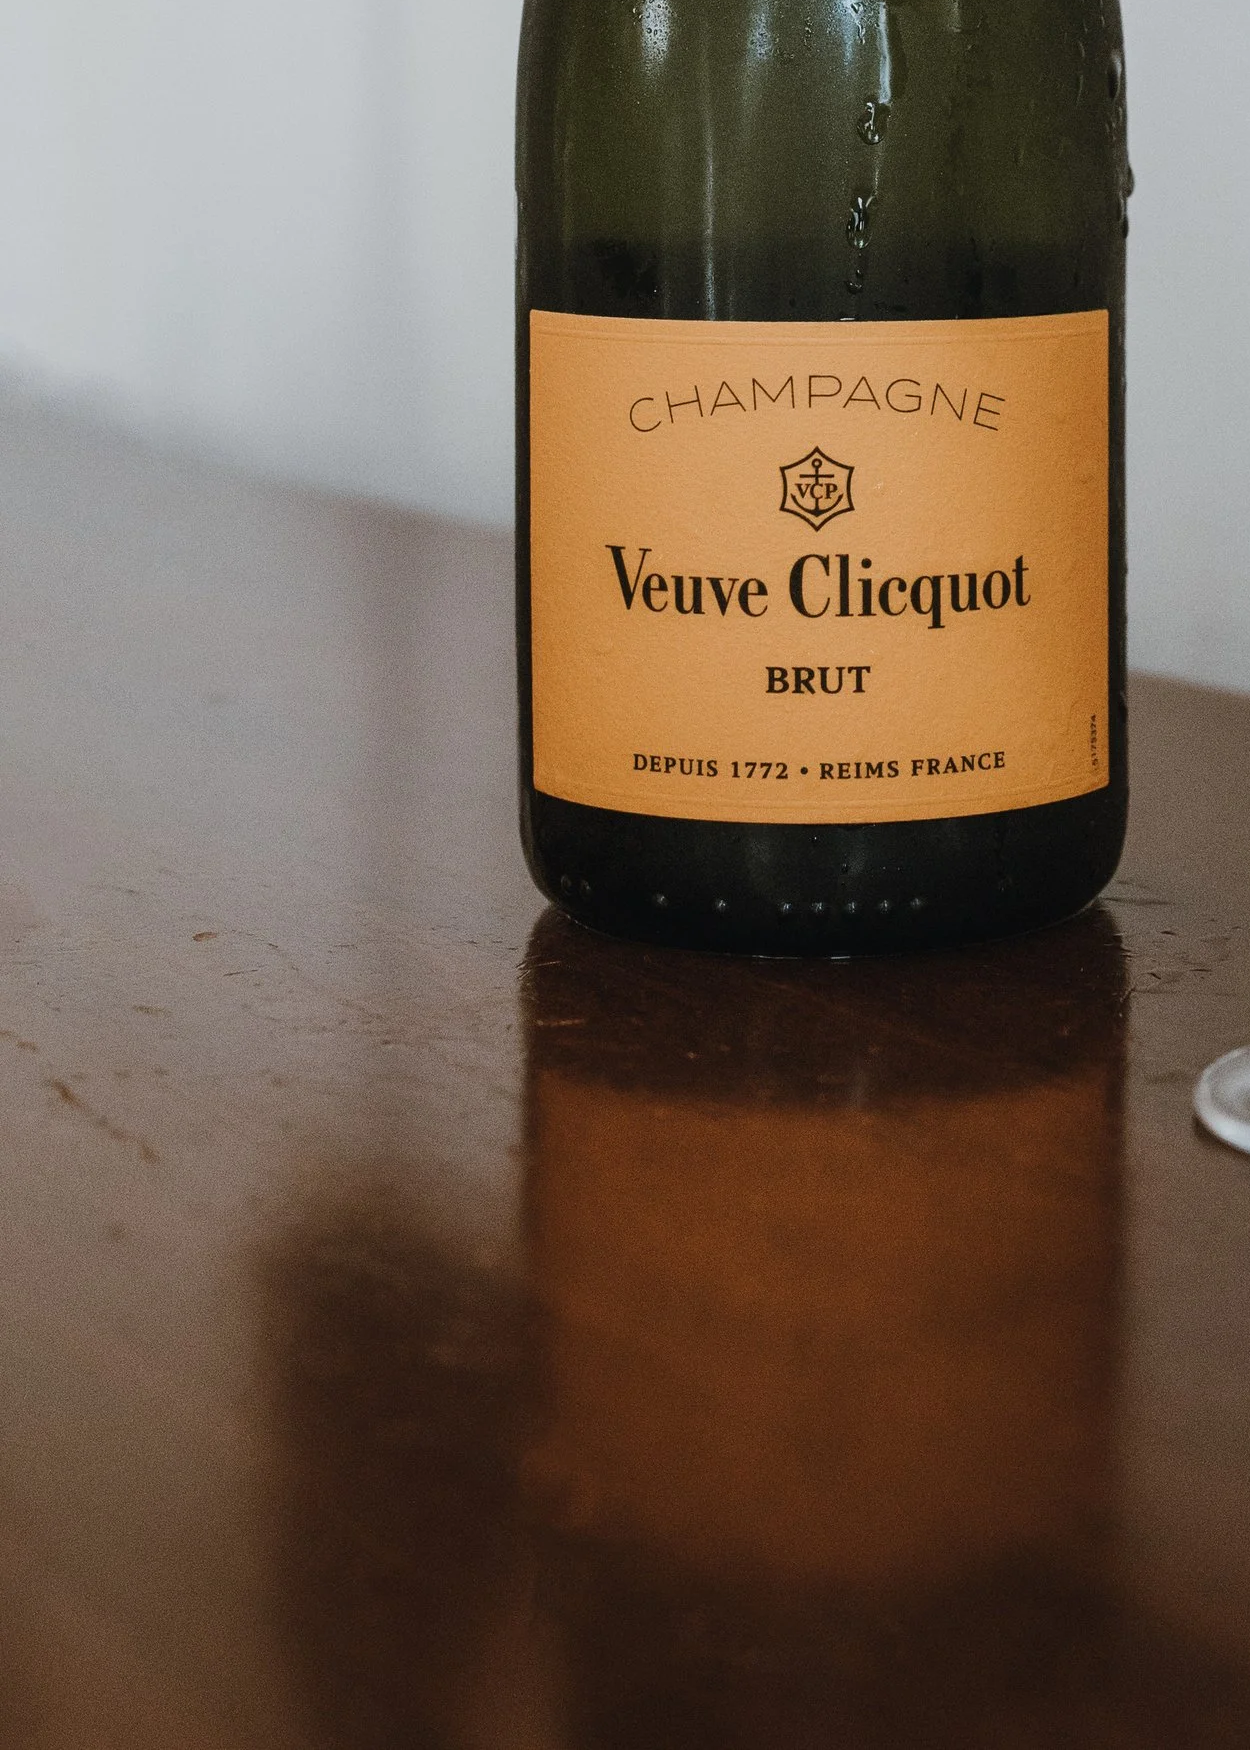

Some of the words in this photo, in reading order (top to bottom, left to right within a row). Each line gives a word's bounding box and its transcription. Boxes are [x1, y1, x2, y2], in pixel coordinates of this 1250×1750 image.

[629, 374, 1005, 433] CHAMPAGNE
[795, 483, 838, 499] VCP
[605, 544, 768, 618] Veuve
[788, 553, 1031, 630] Clicquot
[765, 665, 871, 695] BRUT
[633, 753, 718, 777] DEPUIS
[731, 761, 788, 780] 1772
[819, 760, 899, 780] REIMS
[911, 751, 1005, 777] FRANCE
